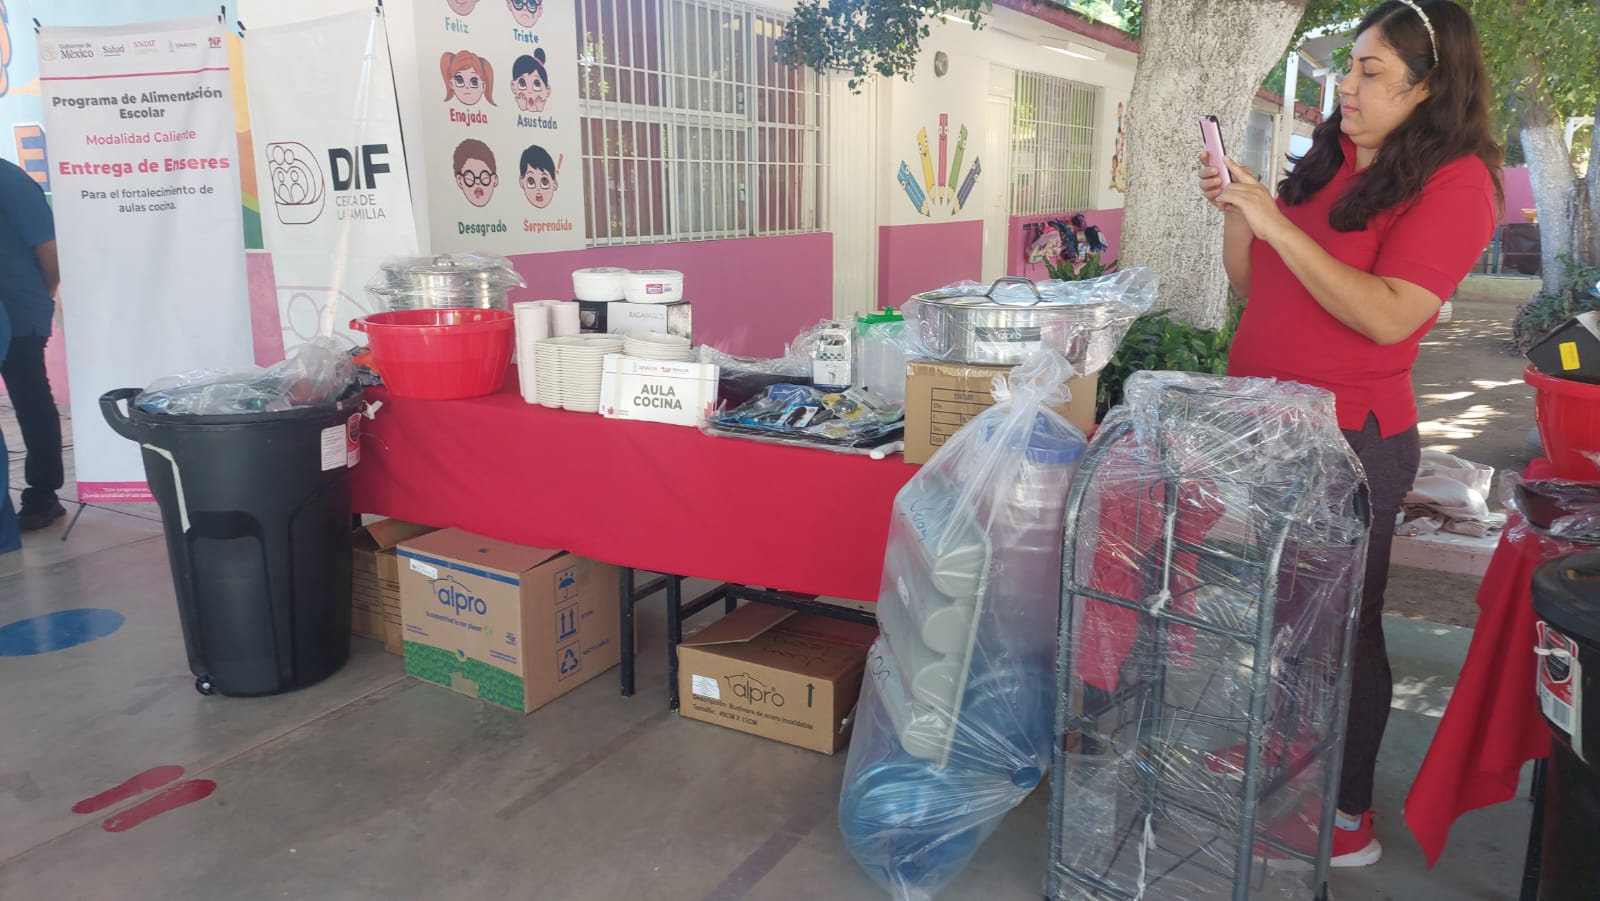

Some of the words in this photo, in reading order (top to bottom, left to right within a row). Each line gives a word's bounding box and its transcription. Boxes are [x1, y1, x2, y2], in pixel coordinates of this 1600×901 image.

[445, 17, 470, 34] Feliz
[512, 28, 539, 44] Triste
[61, 48, 94, 60] México
[102, 44, 125, 54] Salud
[52, 95, 118, 109] Programa
[121, 93, 137, 104] de
[141, 86, 223, 104] Alimentación
[119, 107, 165, 119] Escolar
[449, 108, 488, 126] Enojada
[517, 114, 558, 130] Asustada
[86, 131, 150, 145] Modalidad
[154, 129, 197, 143] Caliente
[58, 160, 133, 177] Entrega
[138, 158, 159, 173] de
[164, 157, 230, 172] Enseres
[328, 144, 391, 191] DIF
[81, 190, 107, 200] Para
[110, 188, 119, 199] el
[121, 185, 196, 199] fortalecimiento
[199, 184, 214, 195] de
[360, 194, 377, 206] DE
[119, 202, 146, 213] aulas
[347, 207, 386, 220] AMILIA
[458, 219, 507, 236] Desagrado
[523, 218, 573, 234] Sorprendido
[640, 384, 676, 397] AULA
[633, 396, 683, 410] COCINA
[438, 585, 487, 616] alpro
[733, 681, 785, 707] alpro
